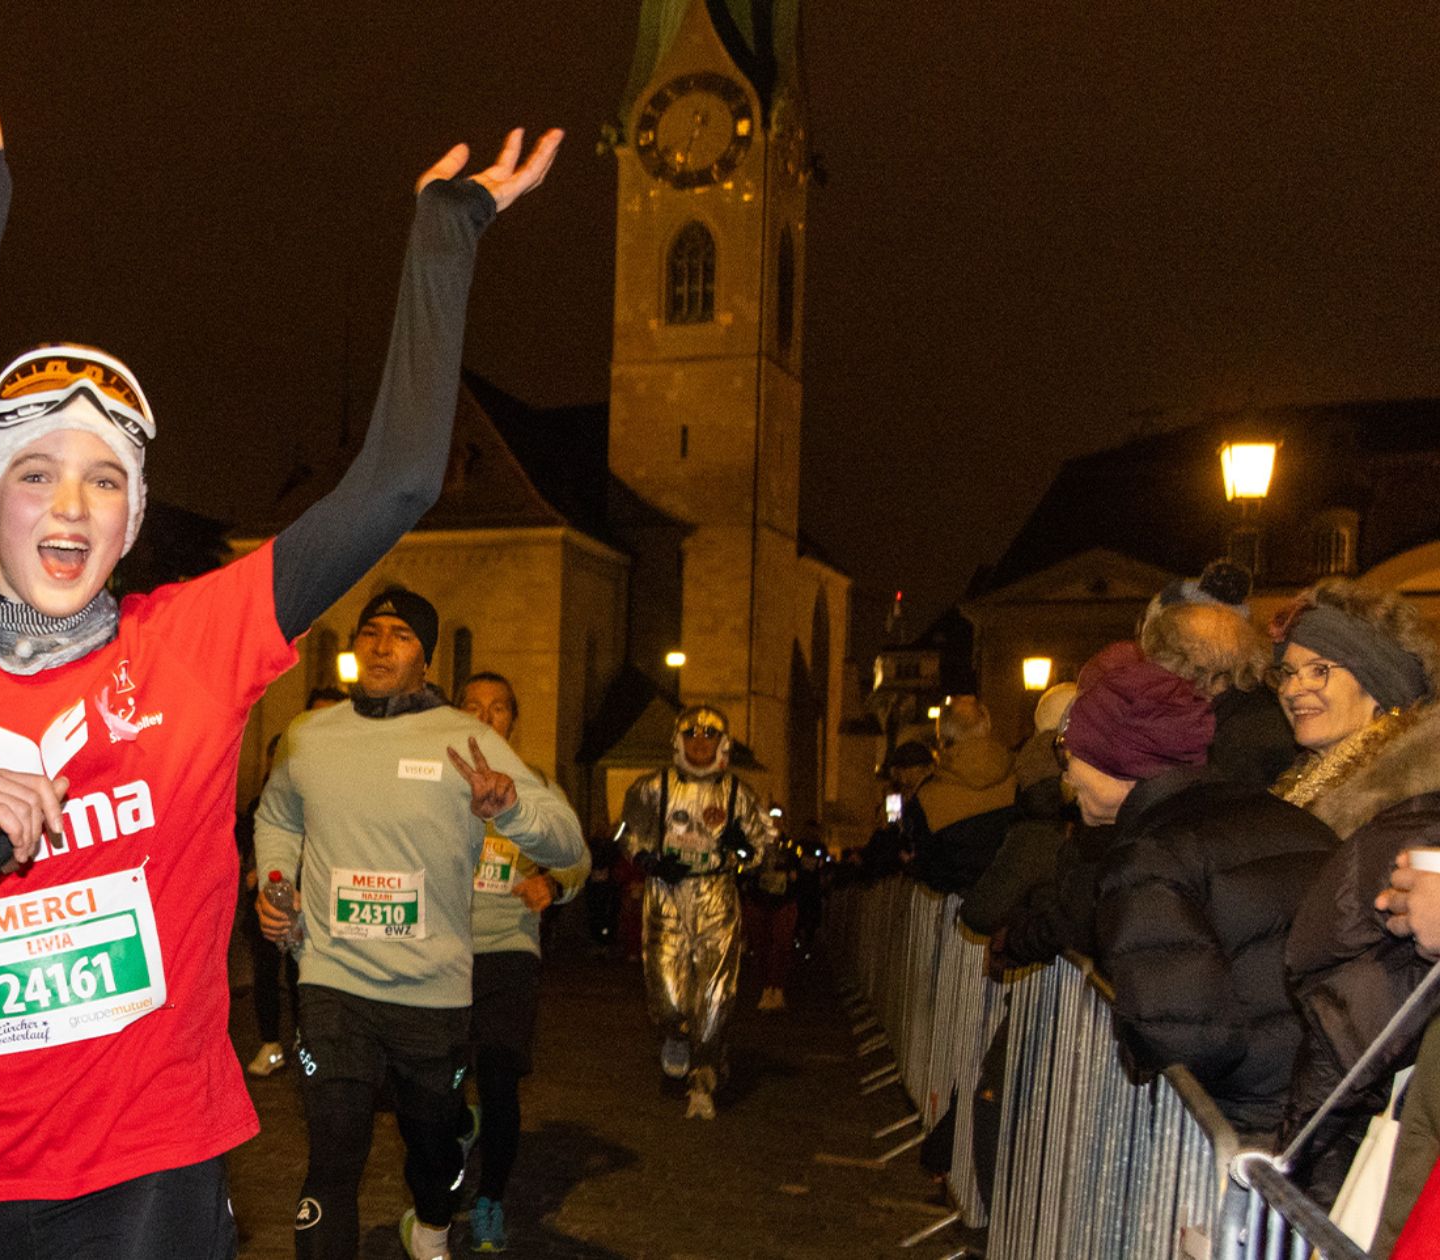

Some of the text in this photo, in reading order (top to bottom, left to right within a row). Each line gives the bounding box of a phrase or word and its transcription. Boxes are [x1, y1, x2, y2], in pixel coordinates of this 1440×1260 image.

[352, 875, 401, 889] MERCI
[348, 902, 406, 924] 24310
[26, 932, 74, 955] LIVIA
[69, 997, 153, 1028] groupemutuel
